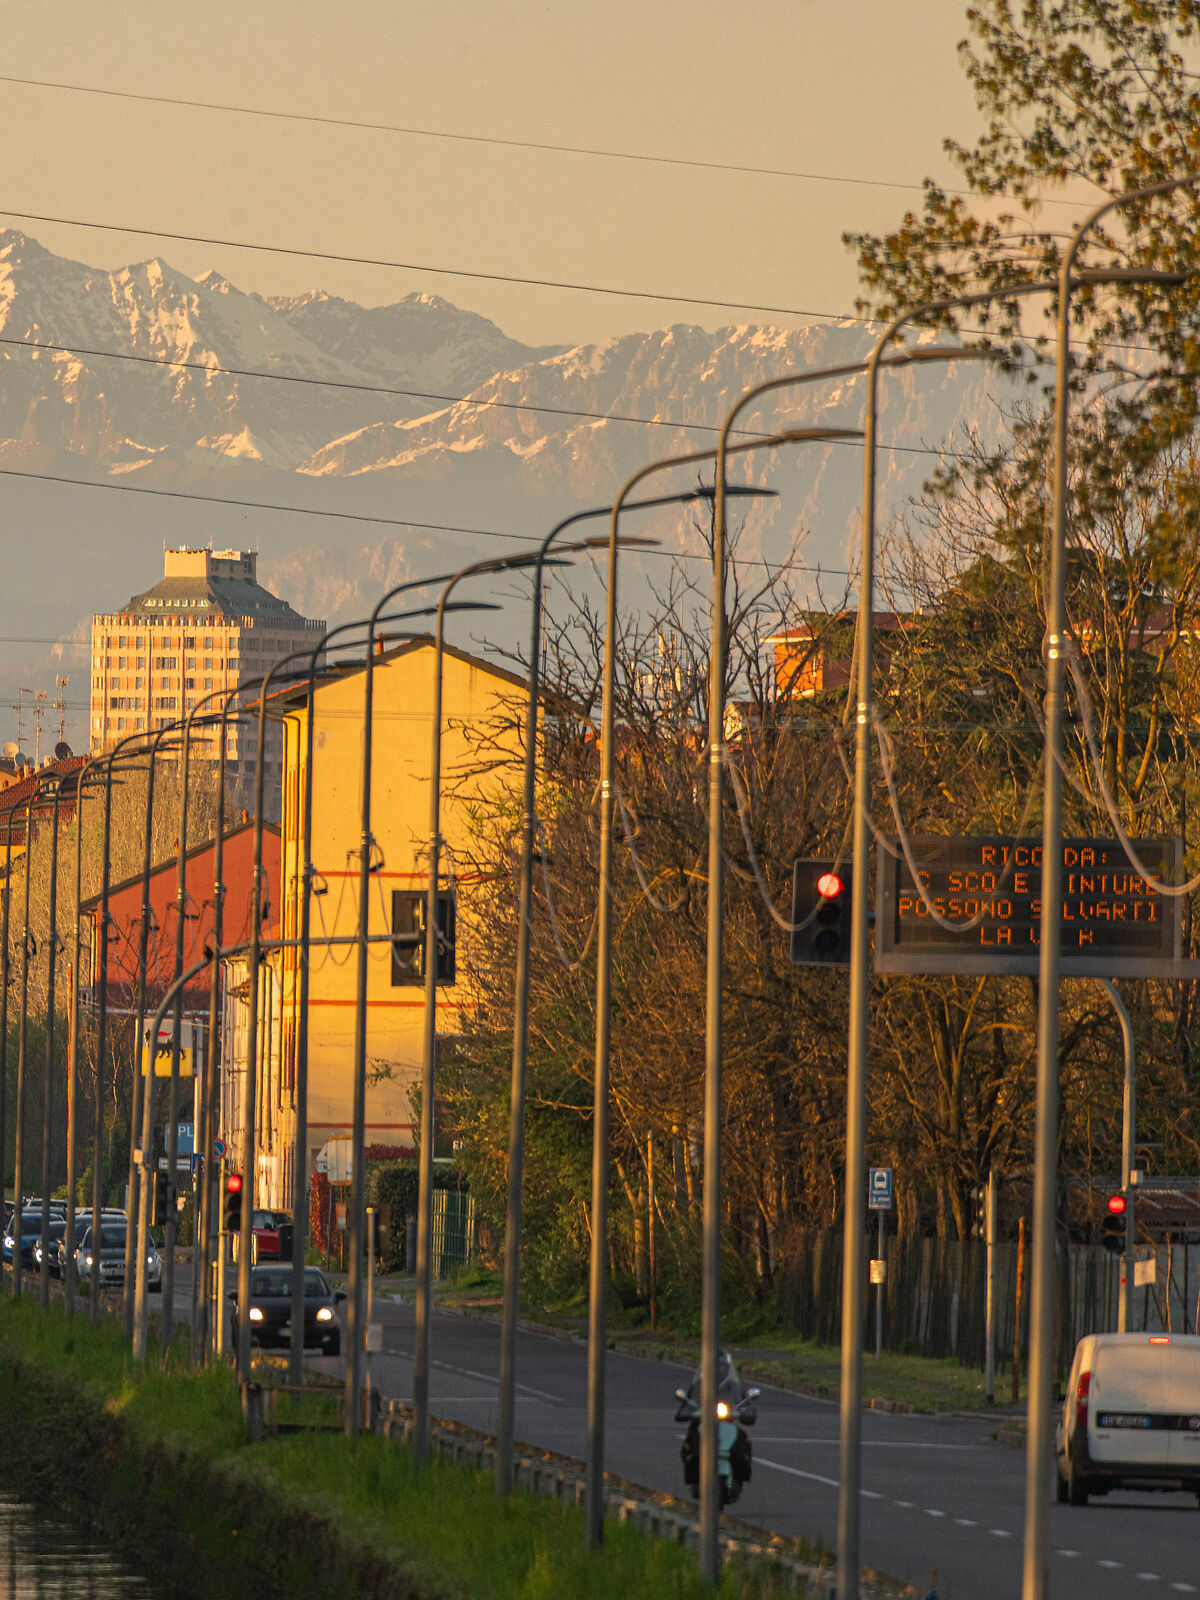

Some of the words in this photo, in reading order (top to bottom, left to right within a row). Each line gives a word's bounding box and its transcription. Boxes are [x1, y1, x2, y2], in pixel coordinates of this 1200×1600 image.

[981, 845, 1107, 868] RICODA:
[917, 870, 996, 893] CSCO
[1068, 873, 1160, 896] INTURE
[898, 896, 1012, 919] POSSONO
[1029, 899, 1157, 921] SLVARTI
[980, 926, 1011, 945] LA
